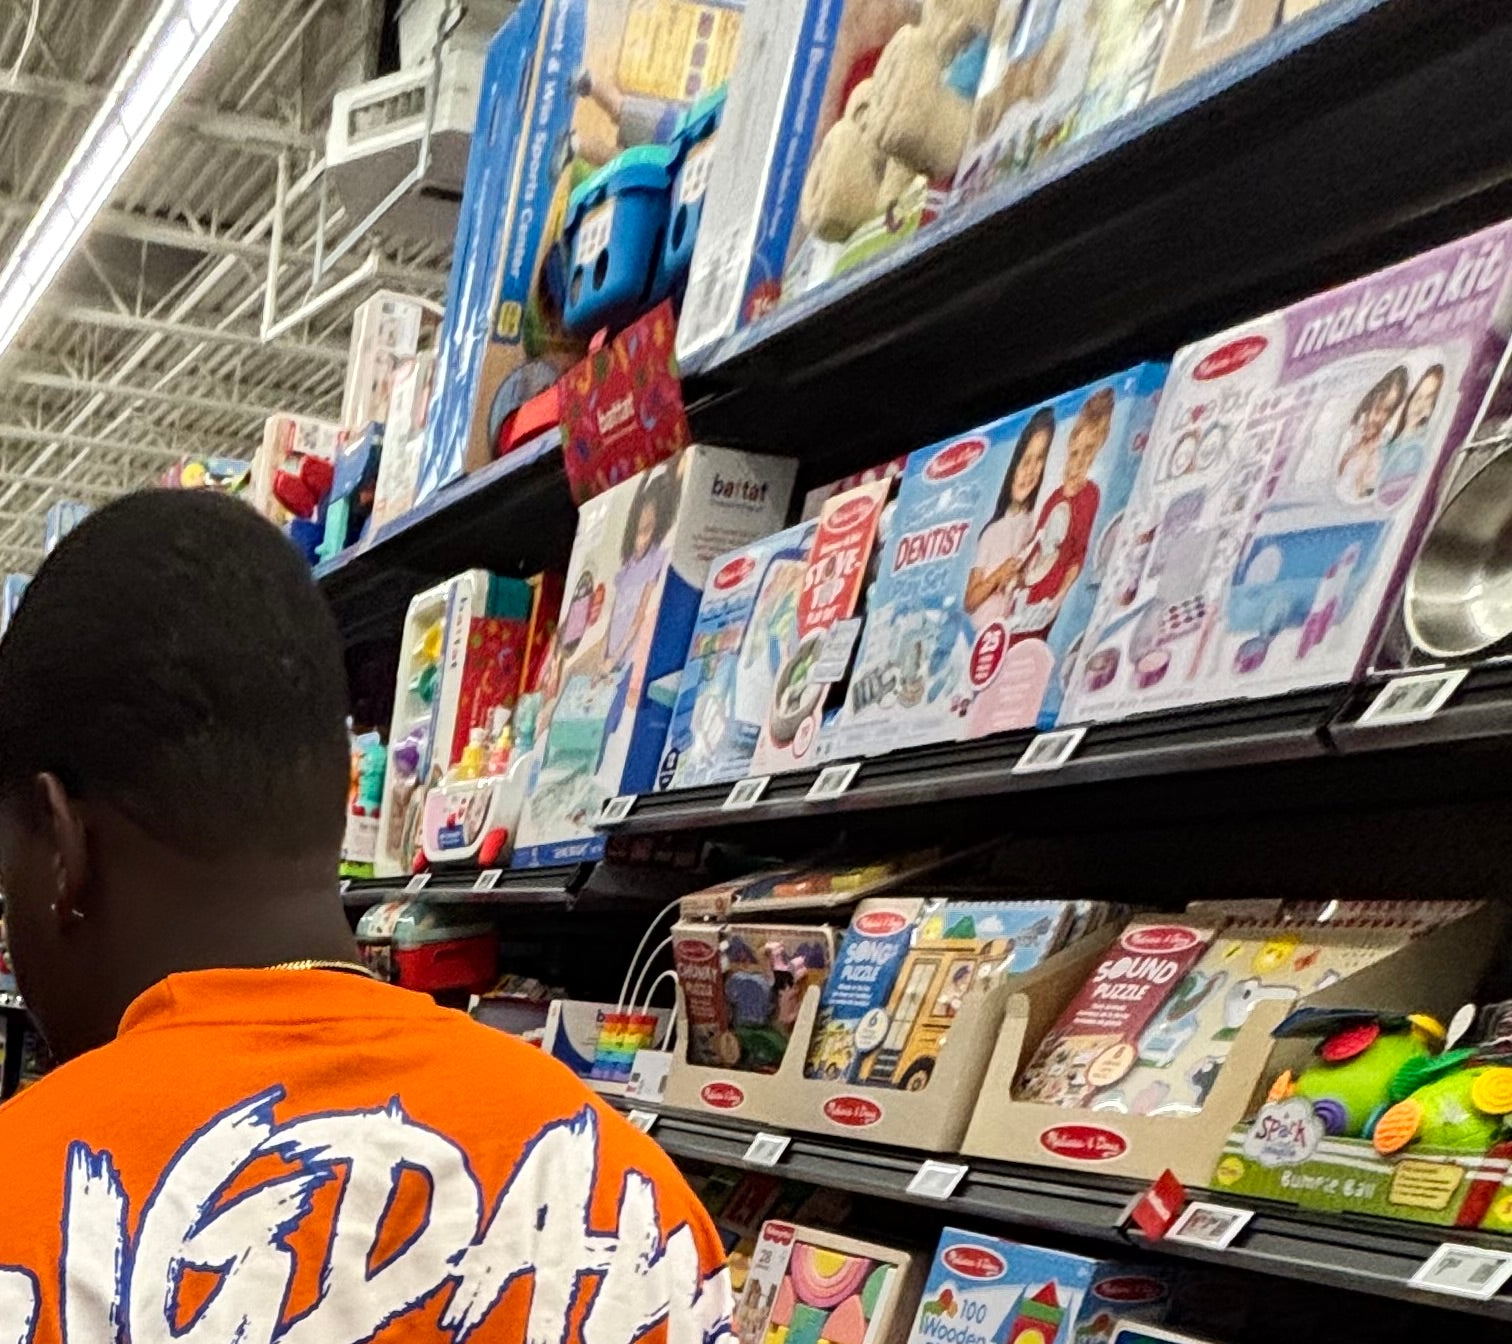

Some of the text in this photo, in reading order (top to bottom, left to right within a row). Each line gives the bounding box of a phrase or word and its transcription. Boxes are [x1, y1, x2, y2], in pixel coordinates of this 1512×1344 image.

[524, 131, 548, 201] Sports
[510, 206, 533, 279] Center
[1292, 271, 1447, 358] makeup
[1438, 238, 1506, 306] kit
[893, 522, 971, 572] DENTIST
[1093, 956, 1178, 984] SOUND
[1091, 982, 1150, 1001] PUZZLE
[868, 1011, 878, 1026] 6
[1341, 1177, 1377, 1200] Ball
[960, 1299, 987, 1324] 100
